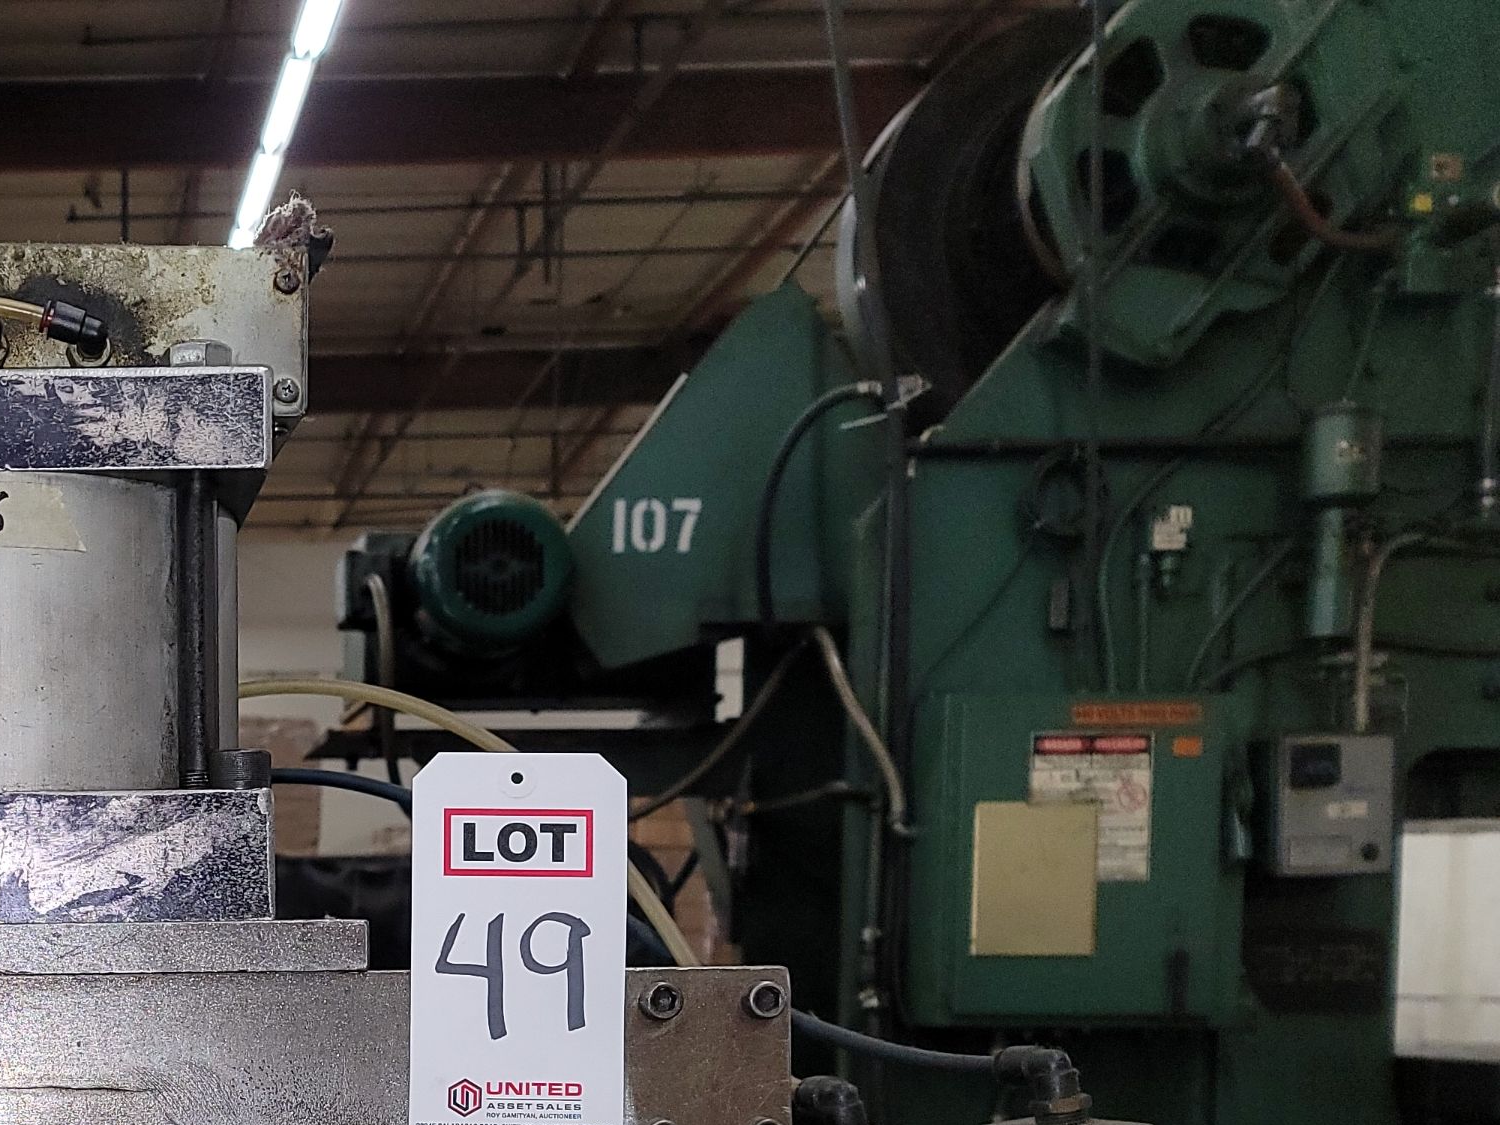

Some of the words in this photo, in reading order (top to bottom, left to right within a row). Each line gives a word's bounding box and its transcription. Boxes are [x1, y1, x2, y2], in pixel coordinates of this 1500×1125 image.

[612, 498, 702, 553] 107
[463, 822, 577, 862] LOT
[435, 912, 591, 1040] 49
[486, 1081, 582, 1096] UNITED
[487, 1102, 532, 1110] ASSET
[536, 1103, 581, 1111] SALES
